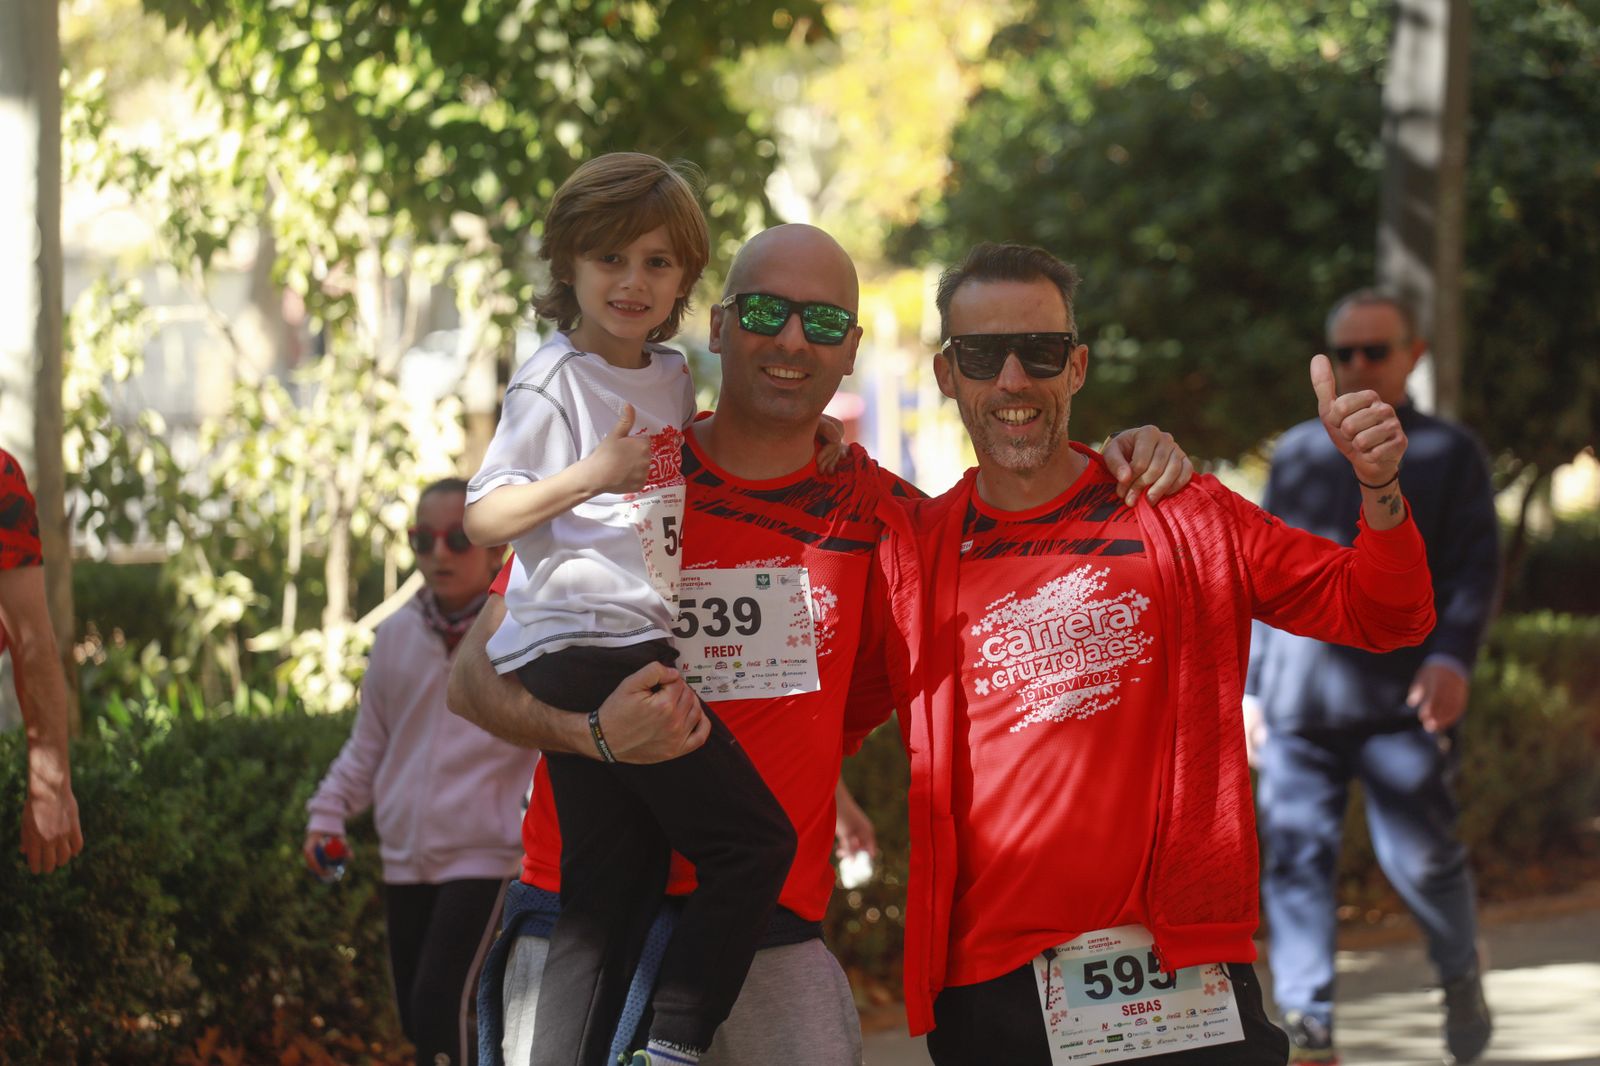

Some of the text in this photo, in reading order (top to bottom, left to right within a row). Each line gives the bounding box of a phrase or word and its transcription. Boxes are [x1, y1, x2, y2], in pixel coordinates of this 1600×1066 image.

[662, 516, 684, 557] 5
[671, 596, 762, 639] 539
[982, 603, 1136, 663] carrera
[704, 645, 743, 658] FREDY
[992, 635, 1141, 689] cruzroja.es
[1083, 951, 1175, 1000] 595
[1121, 999, 1163, 1017] SEBAS
